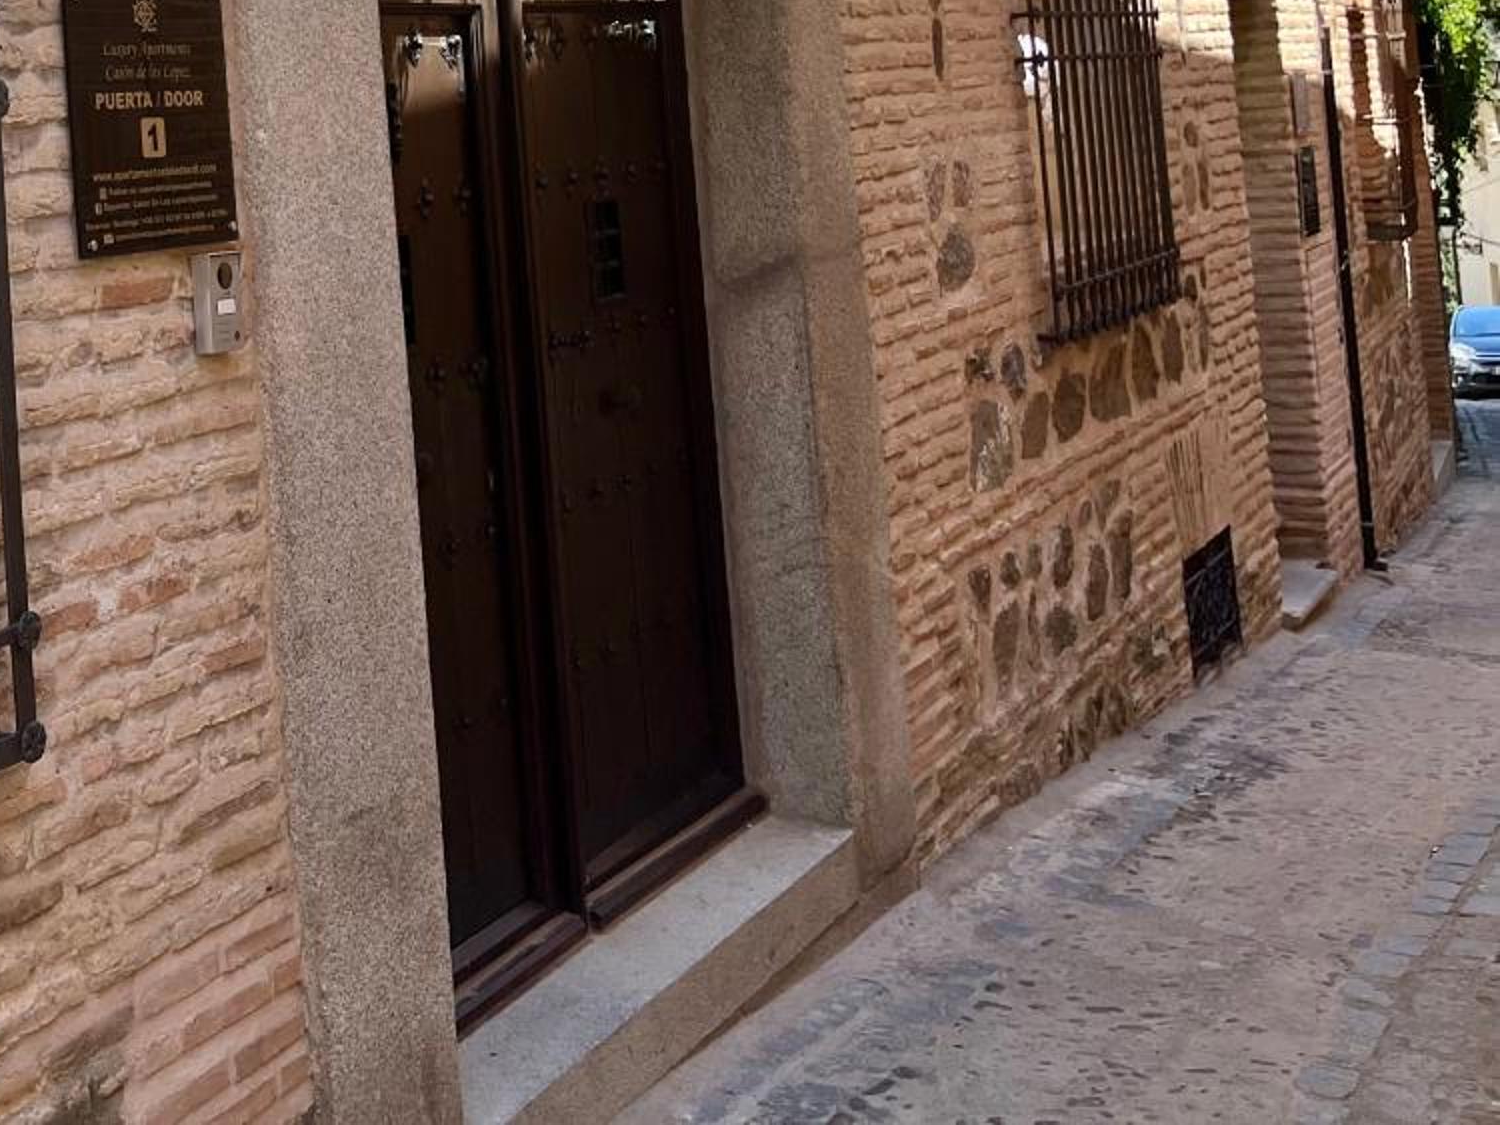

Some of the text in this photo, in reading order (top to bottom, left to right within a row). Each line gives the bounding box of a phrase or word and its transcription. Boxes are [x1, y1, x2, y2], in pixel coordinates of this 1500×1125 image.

[95, 91, 153, 110] PUERTA
[163, 90, 204, 108] DOOR
[147, 123, 159, 152] 1
